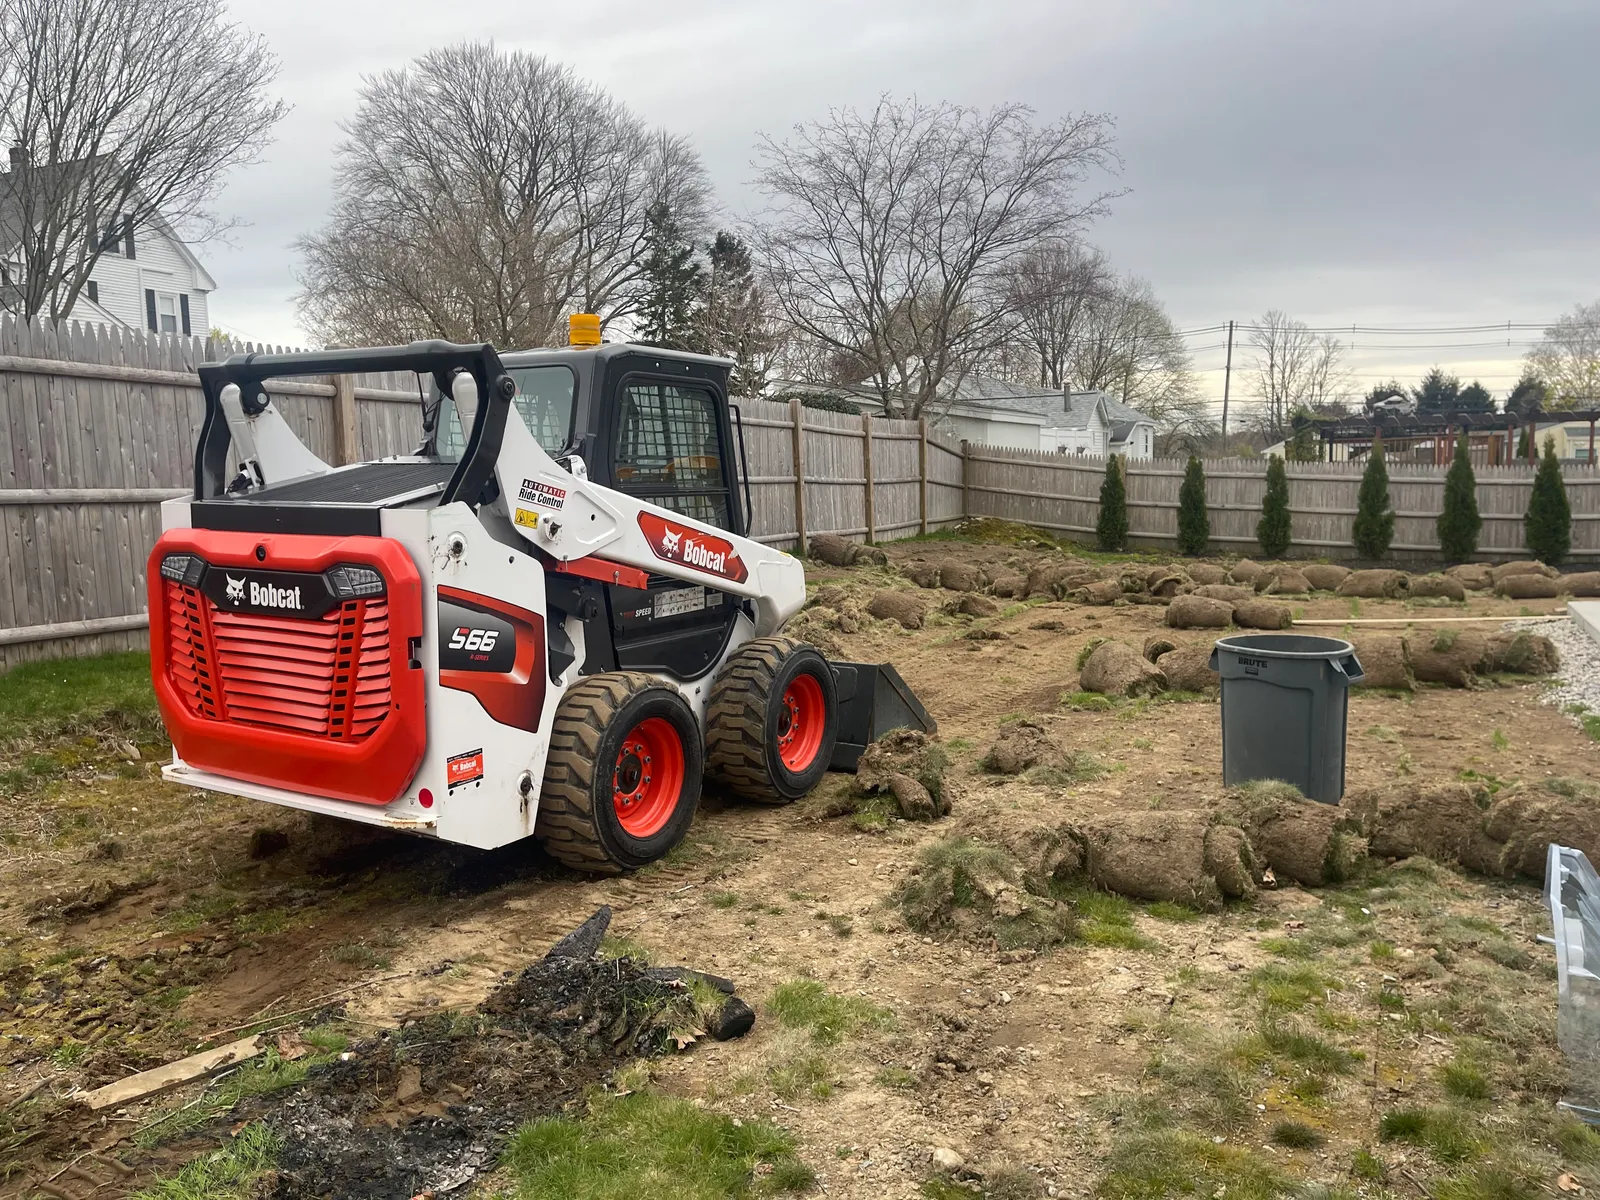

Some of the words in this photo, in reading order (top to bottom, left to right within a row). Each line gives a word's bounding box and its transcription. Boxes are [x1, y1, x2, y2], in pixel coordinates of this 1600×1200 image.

[518, 488, 536, 501] Ride
[537, 493, 564, 508] Control
[523, 481, 565, 498] AUTOMATIC
[683, 539, 725, 573] Bobcat
[250, 582, 301, 609] Bobcat
[635, 607, 651, 617] SPEED
[448, 627, 499, 651] S66
[1238, 656, 1268, 668] BRUTE
